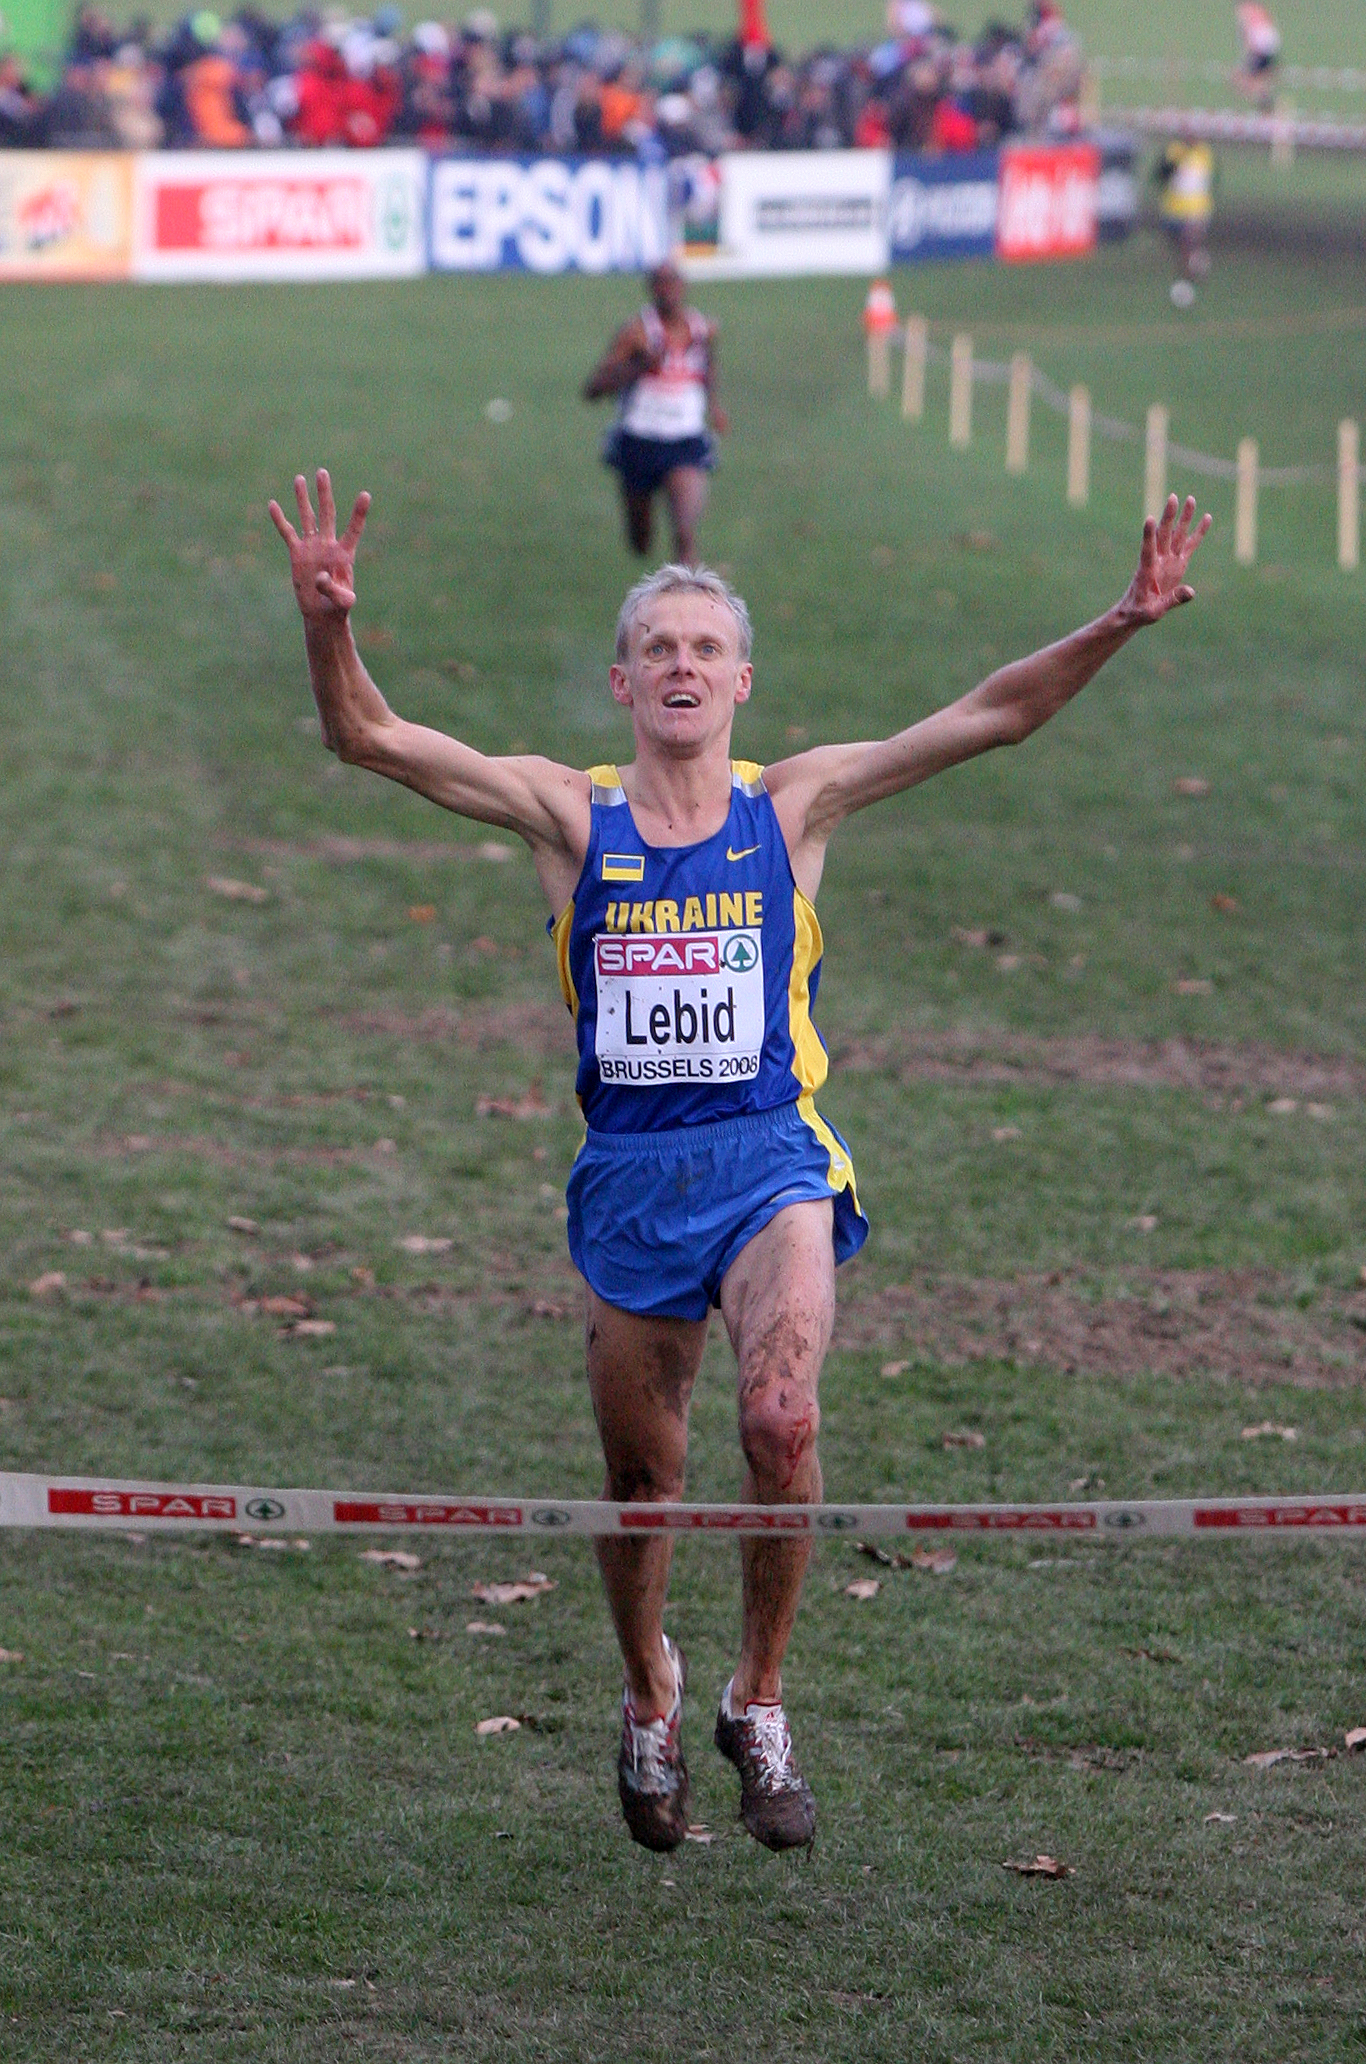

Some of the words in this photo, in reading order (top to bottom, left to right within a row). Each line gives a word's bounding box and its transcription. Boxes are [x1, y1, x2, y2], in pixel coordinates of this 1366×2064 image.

[432, 159, 668, 271] EPSON
[605, 891, 764, 933] UKRAINE
[600, 941, 717, 972] SPAR
[625, 986, 736, 1046] Lebid
[601, 1058, 714, 1080] BRUSSELS
[718, 1055, 758, 1079] 2008
[91, 1494, 233, 1516] SPAR
[378, 1504, 518, 1523] SPAR
[664, 1511, 804, 1527] SPAR
[950, 1511, 1092, 1527] SPAR
